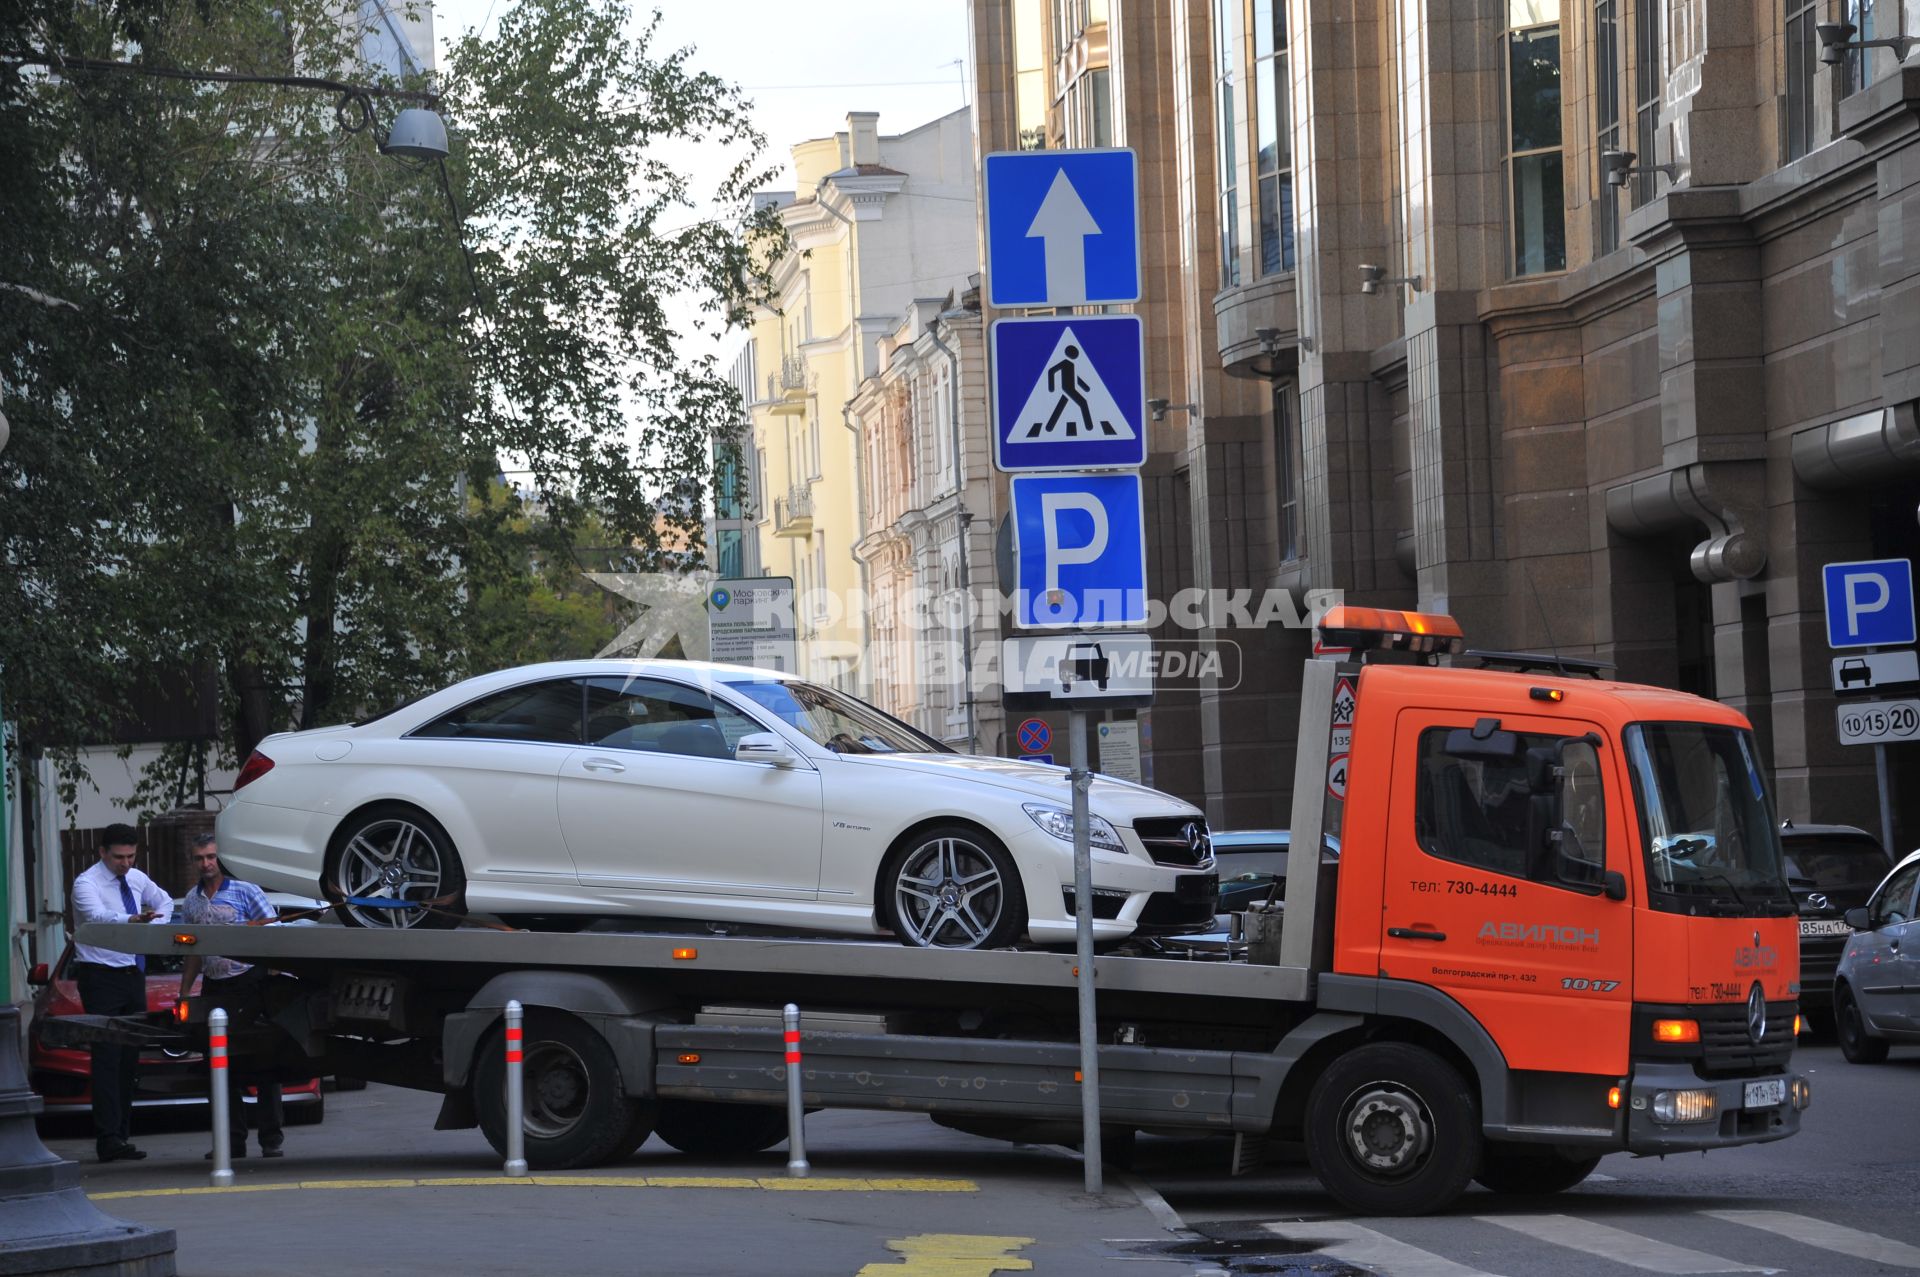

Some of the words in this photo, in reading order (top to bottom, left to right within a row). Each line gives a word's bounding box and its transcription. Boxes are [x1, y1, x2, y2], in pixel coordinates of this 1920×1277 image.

[1041, 492, 1109, 604] P
[733, 589, 789, 598] Московский
[733, 598, 769, 606] паркинг
[1844, 572, 1890, 636] P
[1845, 717, 1861, 732] 10
[1865, 713, 1885, 731] 15
[1890, 708, 1915, 730] 20
[1411, 881, 1441, 893] тел:
[1446, 880, 1518, 898] 730-4444
[1477, 921, 1600, 944] АВИЛОН
[1799, 922, 1833, 934] 85НА
[1431, 966, 1496, 979] Волгоградский
[1561, 978, 1621, 992] 1017
[1711, 983, 1741, 999] 730-4444
